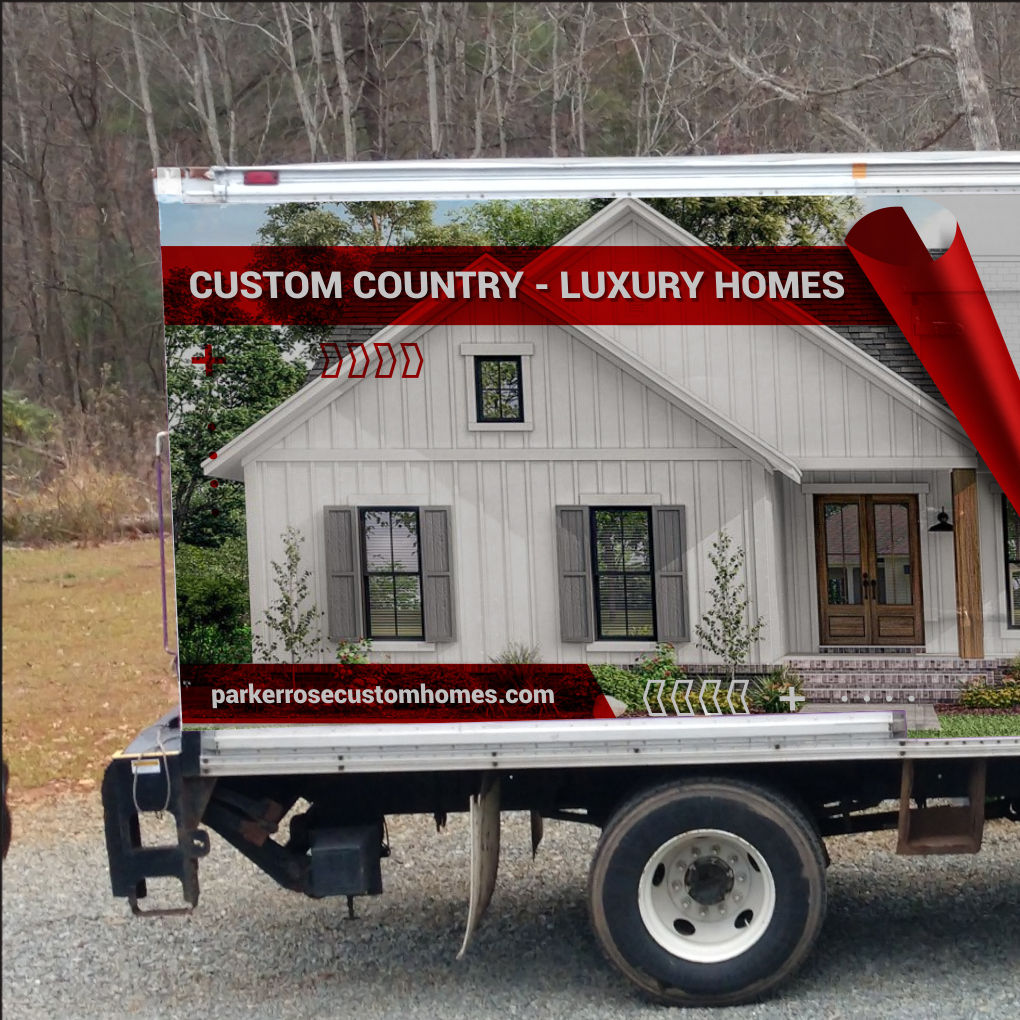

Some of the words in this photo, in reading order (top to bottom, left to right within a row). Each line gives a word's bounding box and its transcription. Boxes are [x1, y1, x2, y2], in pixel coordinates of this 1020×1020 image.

[189, 270, 342, 299] CUSTOM
[353, 270, 524, 299] COUNTRY
[560, 271, 704, 299] LUXURY
[715, 270, 845, 299] HOMES
[211, 683, 555, 709] parkerrosecustomhomes.com
